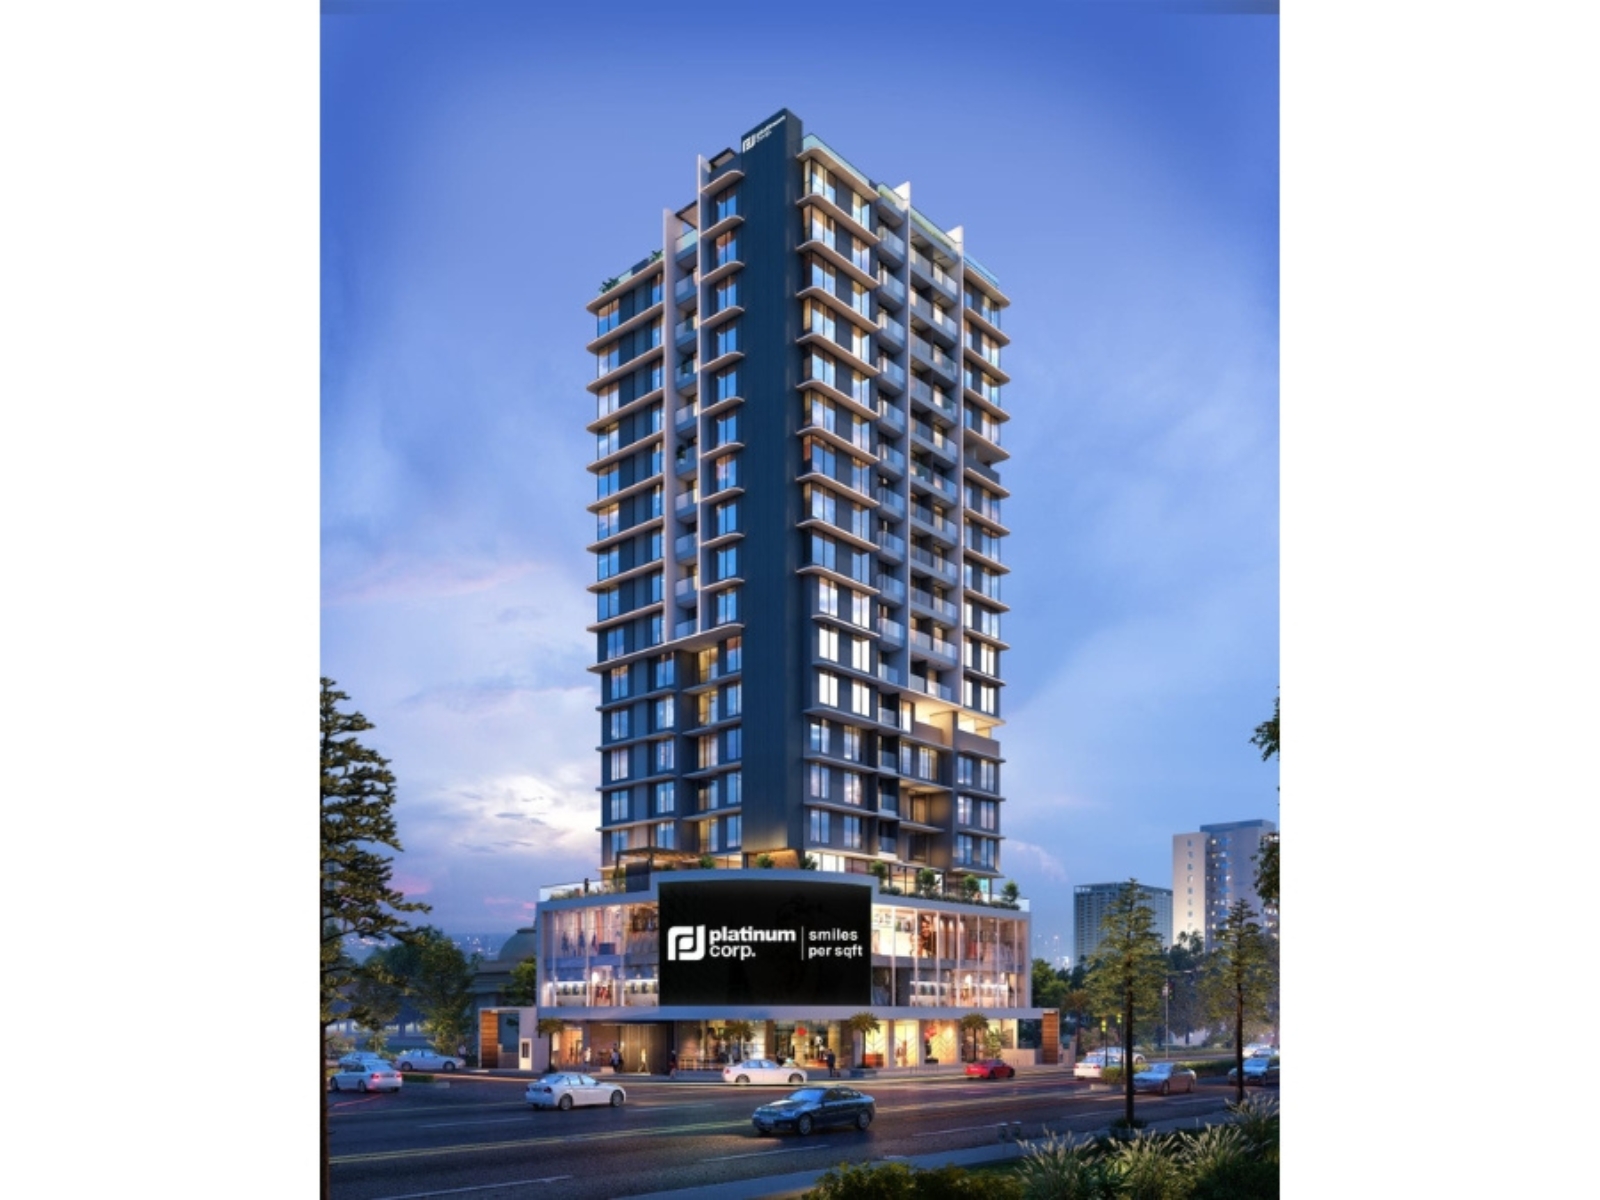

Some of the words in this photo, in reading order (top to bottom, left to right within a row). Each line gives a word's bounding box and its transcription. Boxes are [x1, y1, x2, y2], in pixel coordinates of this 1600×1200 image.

[709, 926, 796, 944] platinum
[809, 928, 858, 942] smiles
[709, 945, 756, 961] corp.
[809, 945, 832, 959] per
[835, 944, 863, 959] sqft
